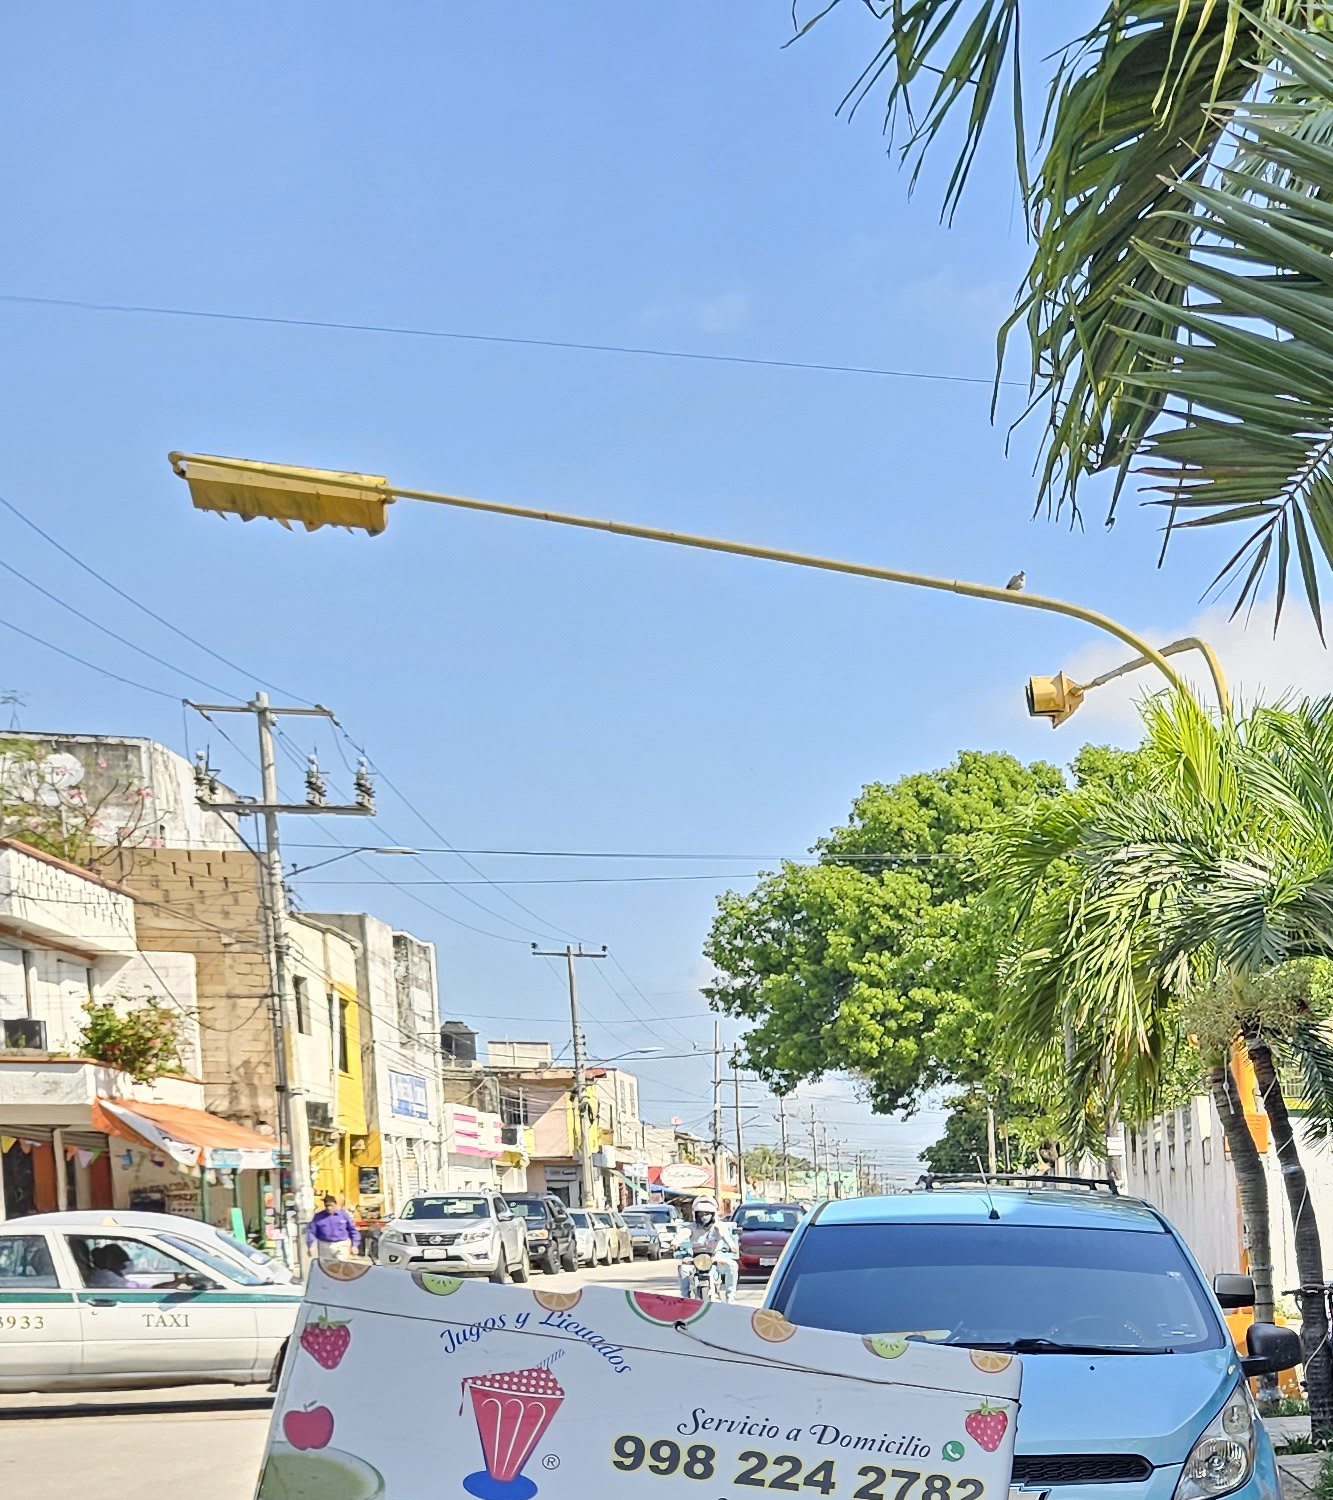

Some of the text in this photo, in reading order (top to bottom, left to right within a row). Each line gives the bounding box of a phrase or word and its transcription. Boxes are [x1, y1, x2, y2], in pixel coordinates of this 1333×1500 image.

[142, 1313, 190, 1328] TAXI
[440, 1311, 632, 1374] Jugos y Licuados
[676, 1407, 931, 1458] Servicio a Domicilio
[612, 1435, 716, 1481] 998
[733, 1450, 836, 1496] 224
